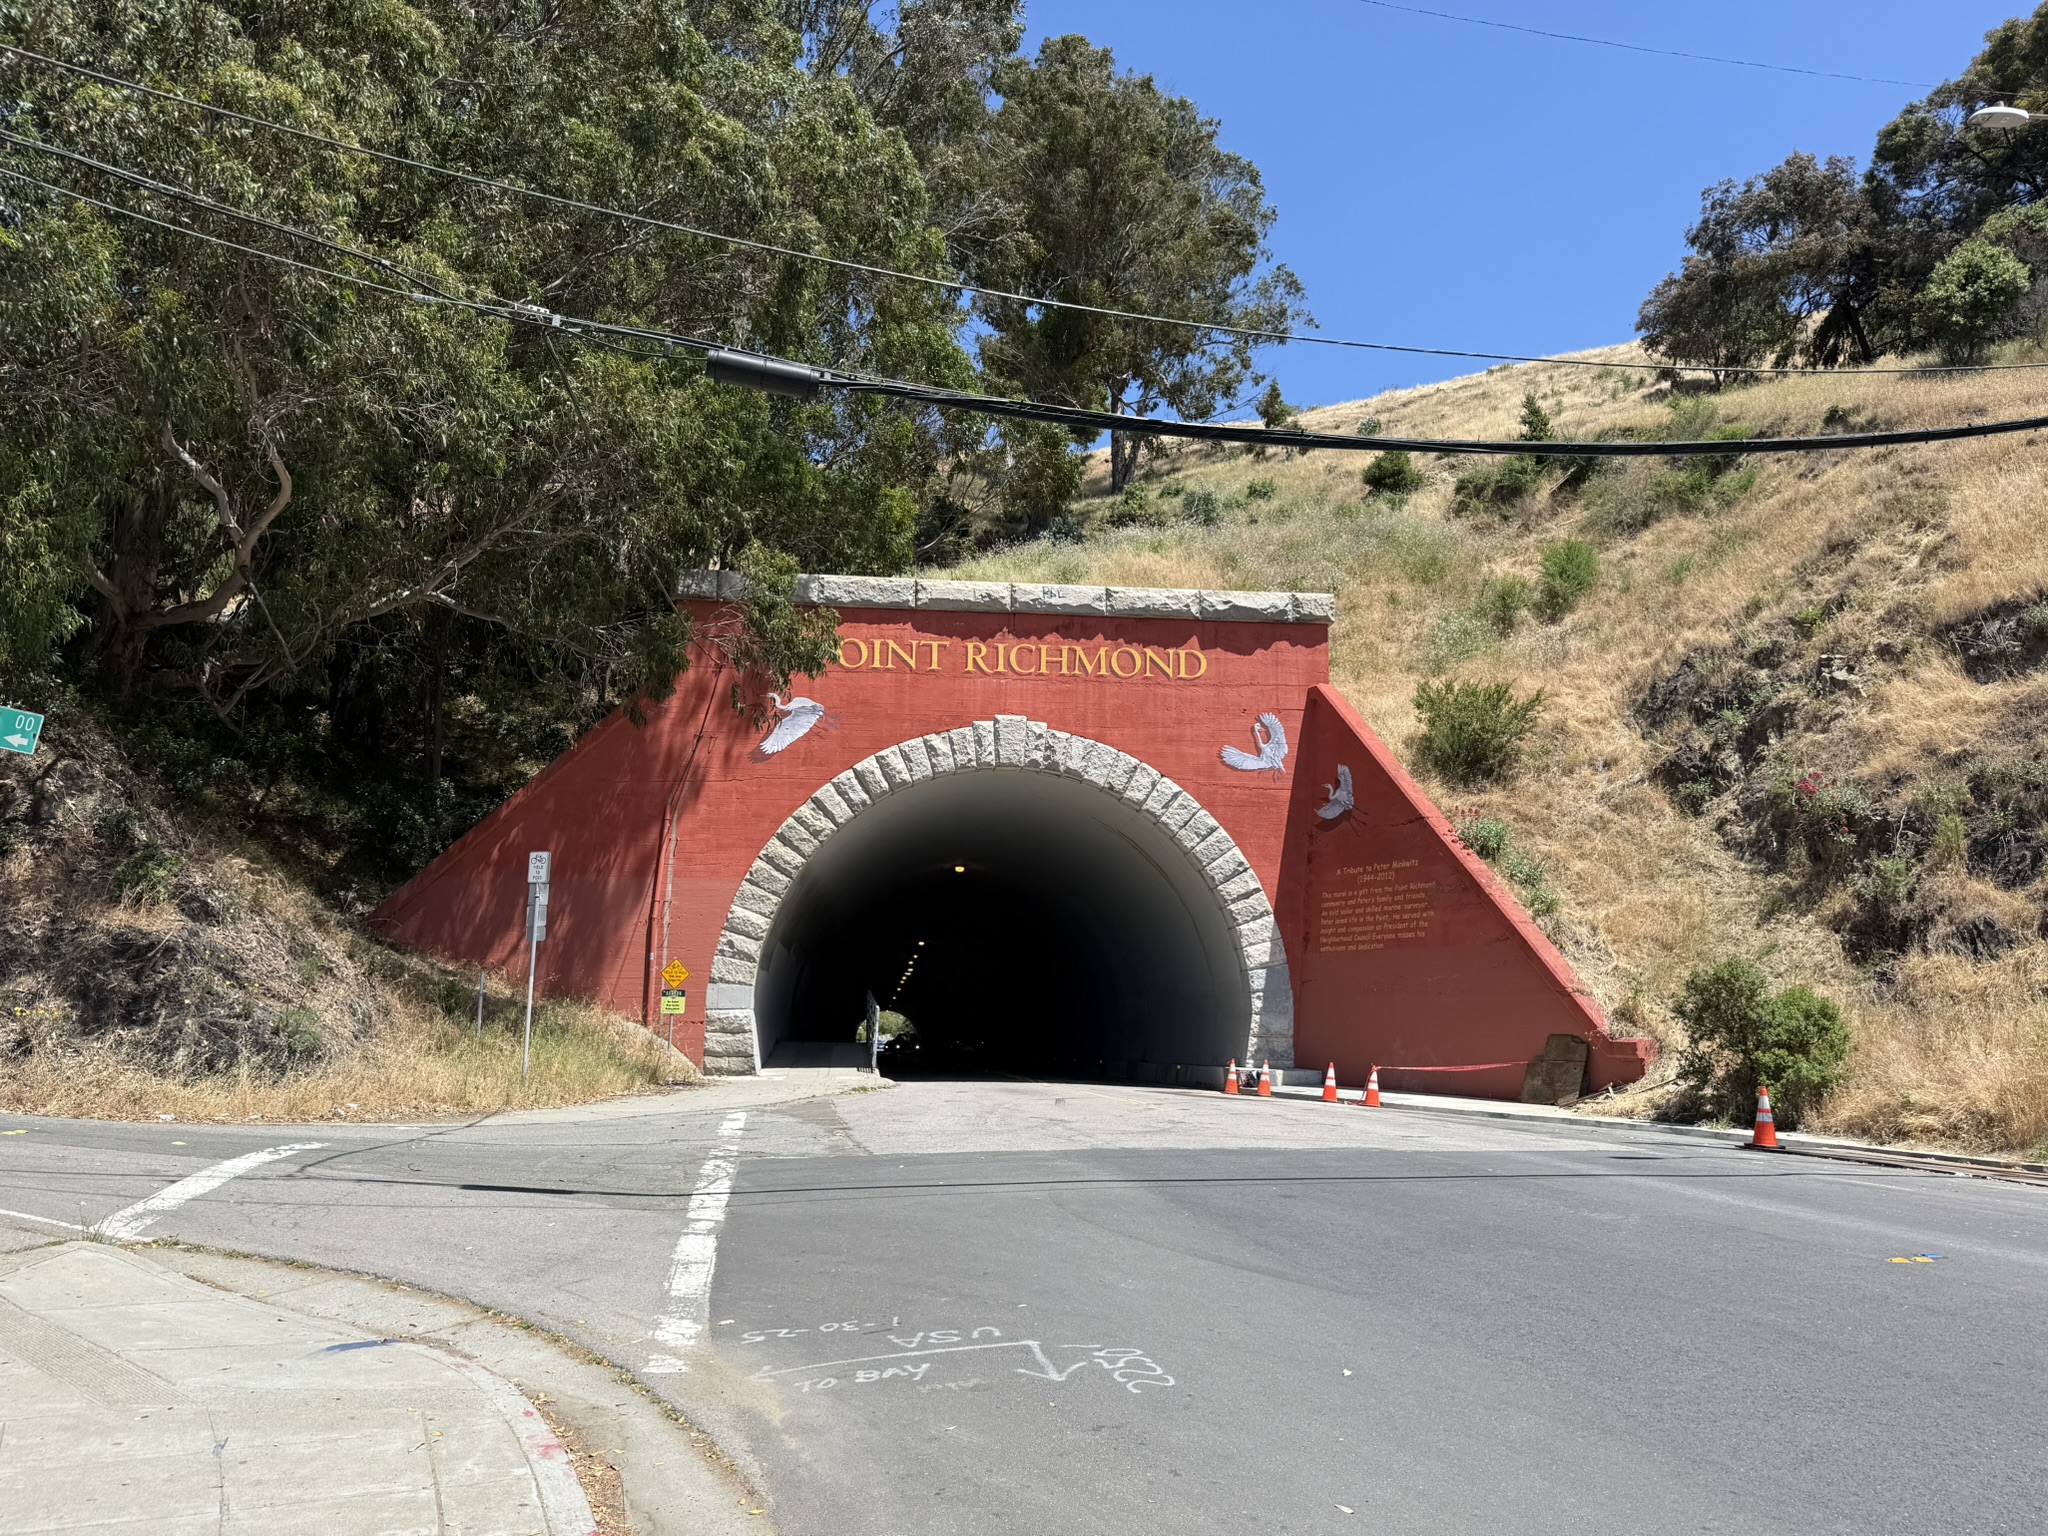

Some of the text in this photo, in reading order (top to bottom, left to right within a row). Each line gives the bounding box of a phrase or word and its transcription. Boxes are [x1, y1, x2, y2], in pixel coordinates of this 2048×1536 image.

[836, 638, 1208, 679] OINT RICHMOND
[15, 715, 35, 731] 00
[1343, 866, 1363, 874] Tribute
[1357, 872, 1395, 884] (1944-2012)
[1333, 890, 1347, 898] mural
[1358, 888, 1369, 898] gift
[1370, 887, 1383, 895] from
[1395, 884, 1408, 892] Point
[1409, 880, 1436, 890] Richmond
[1376, 895, 1392, 904] family
[1365, 905, 1381, 913] skilled
[1320, 918, 1334, 926] Peter
[1392, 912, 1401, 920] He
[1402, 911, 1421, 920] served
[1422, 909, 1435, 917] with
[1347, 924, 1375, 933] compassion
[1383, 921, 1409, 930] President
[1418, 920, 1428, 928] the
[1372, 932, 1396, 941] Everyone
[1397, 931, 1415, 939] misses
[1417, 930, 1425, 938] his
[1347, 943, 1356, 951] and
[887, 1326, 1001, 1347] USA
[855, 1363, 931, 1382] BAY
